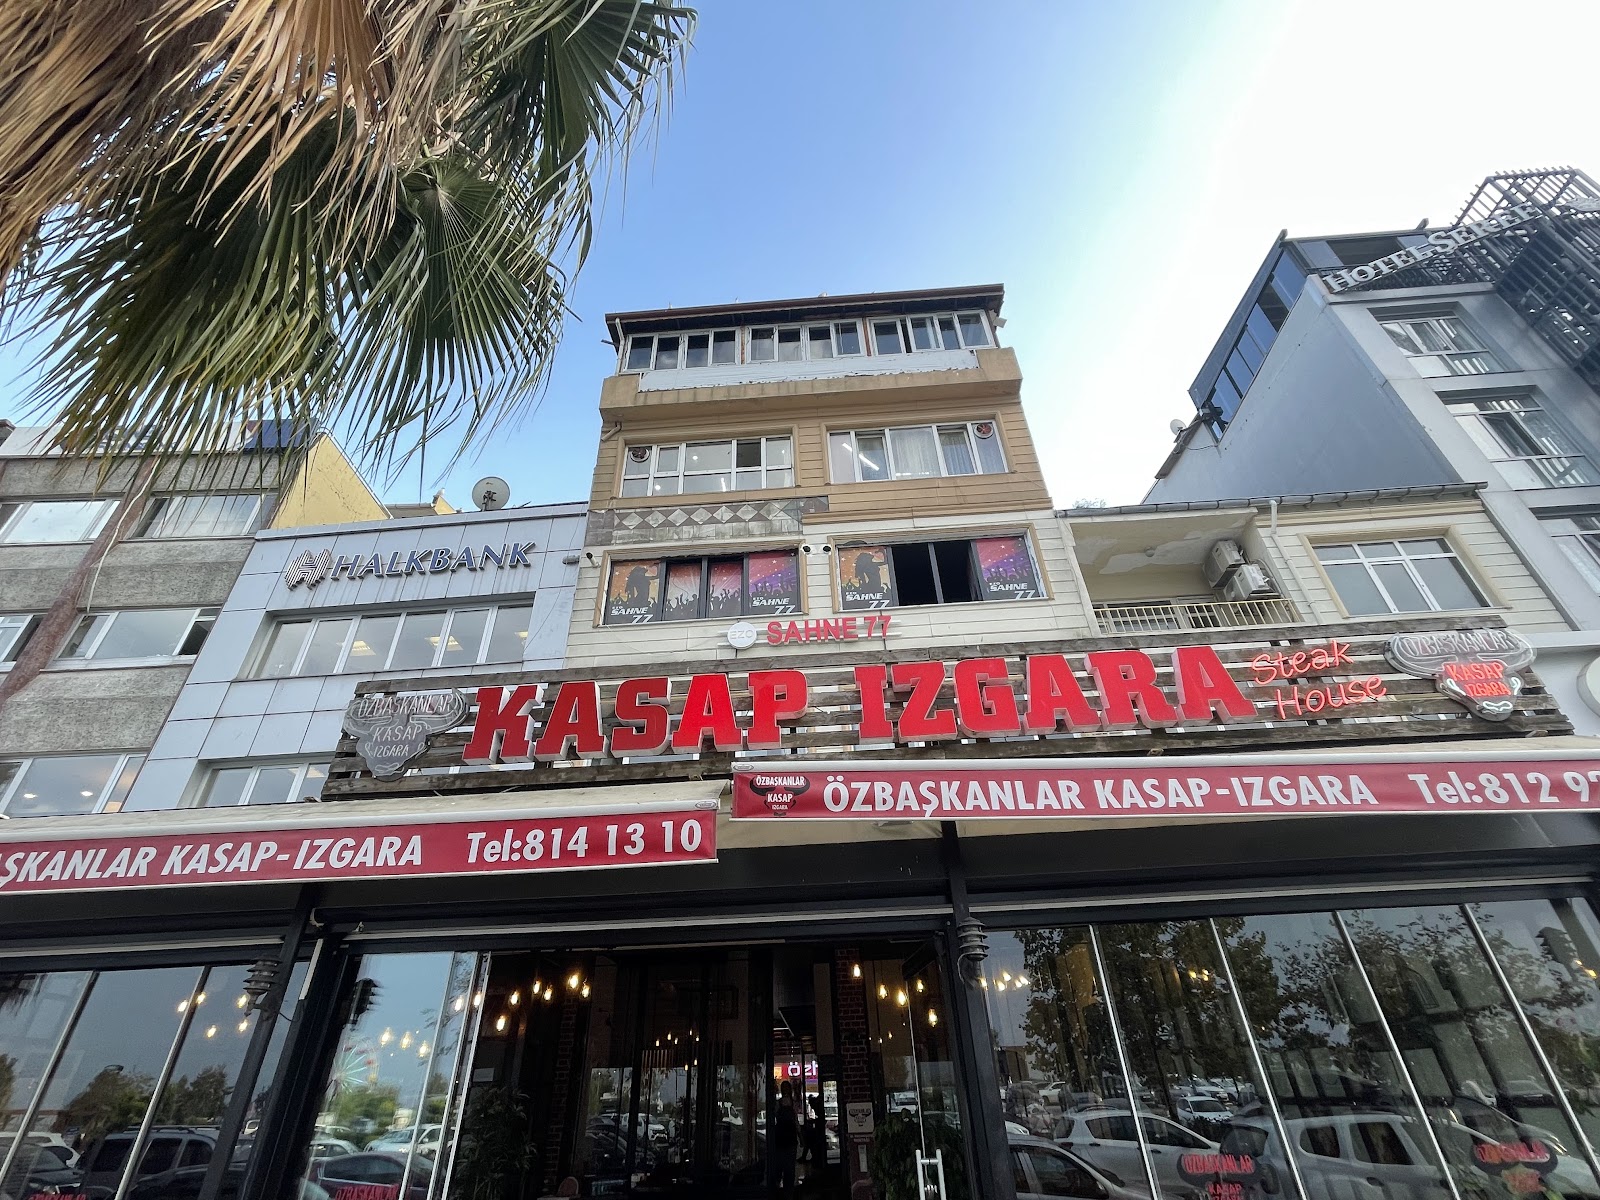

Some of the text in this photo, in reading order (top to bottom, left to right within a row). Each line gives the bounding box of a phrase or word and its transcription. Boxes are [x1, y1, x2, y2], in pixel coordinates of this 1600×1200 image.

[1323, 245, 1435, 293] HOTEL
[330, 541, 535, 580] HALKBANK
[990, 582, 1028, 592] SAHNE
[1014, 590, 1035, 599] 77
[752, 597, 790, 607] SAHNE
[845, 592, 883, 601] SAHNE
[868, 600, 890, 609] 77
[611, 607, 648, 616] SAHNE
[774, 605, 796, 615] 77
[632, 614, 653, 624] 77
[729, 615, 892, 646] EZO SAHNE 77
[1252, 640, 1354, 685] Steak
[1445, 661, 1504, 682] KASAP
[1464, 681, 1512, 697] IZGARA
[462, 645, 1258, 766] KASAP IZGARA
[1276, 675, 1387, 720] House
[373, 725, 422, 742] KASAP
[373, 744, 409, 758] IZGARA
[767, 793, 793, 803] KASAP
[823, 775, 1085, 817] ÖZBAŞKANLAR
[1093, 774, 1379, 809] KASAP-IZGARA
[1408, 771, 1560, 805] Tel:812
[0, 819, 702, 889] ŞKANLAR KASAP-IZGARA Tel:814 13 10
